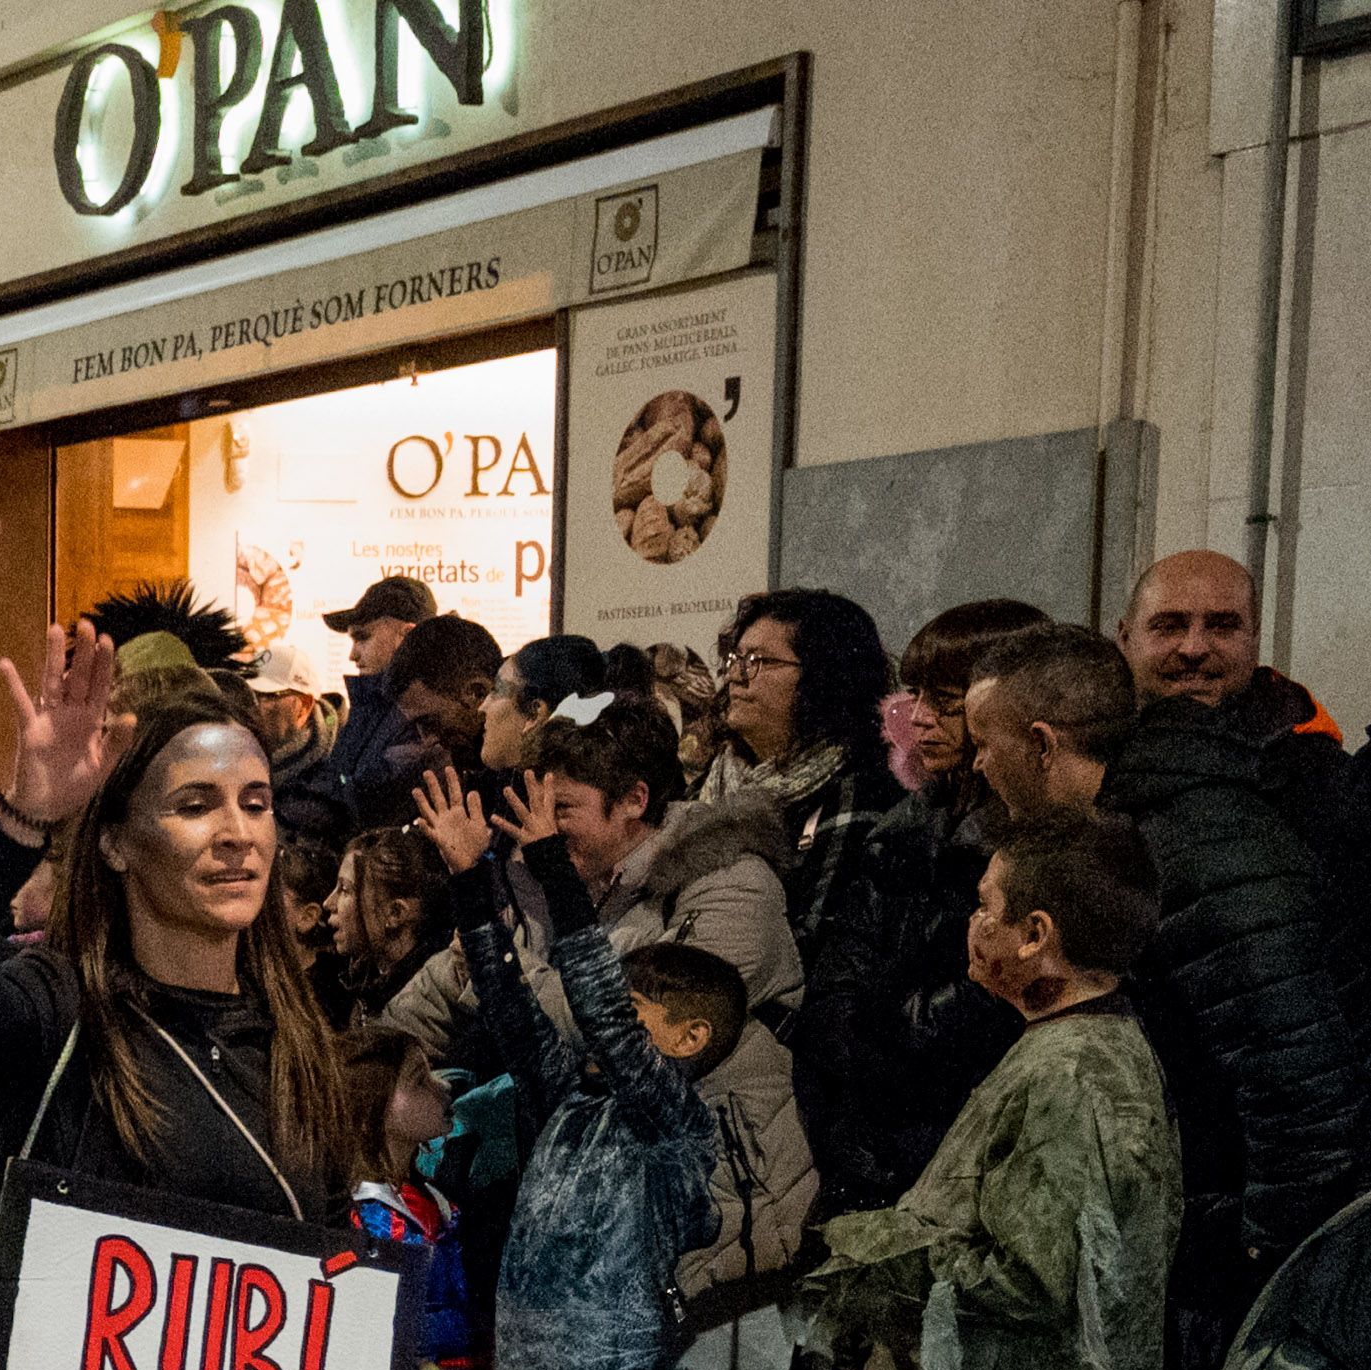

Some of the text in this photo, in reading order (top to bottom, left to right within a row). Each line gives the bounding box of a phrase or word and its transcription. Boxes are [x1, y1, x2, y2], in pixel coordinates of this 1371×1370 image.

[54, 0, 484, 216] O'PAN
[71, 257, 502, 385] FEM BON PA, PERQUÈ SOM FORNERS
[352, 541, 380, 558] Les
[514, 540, 552, 597] p
